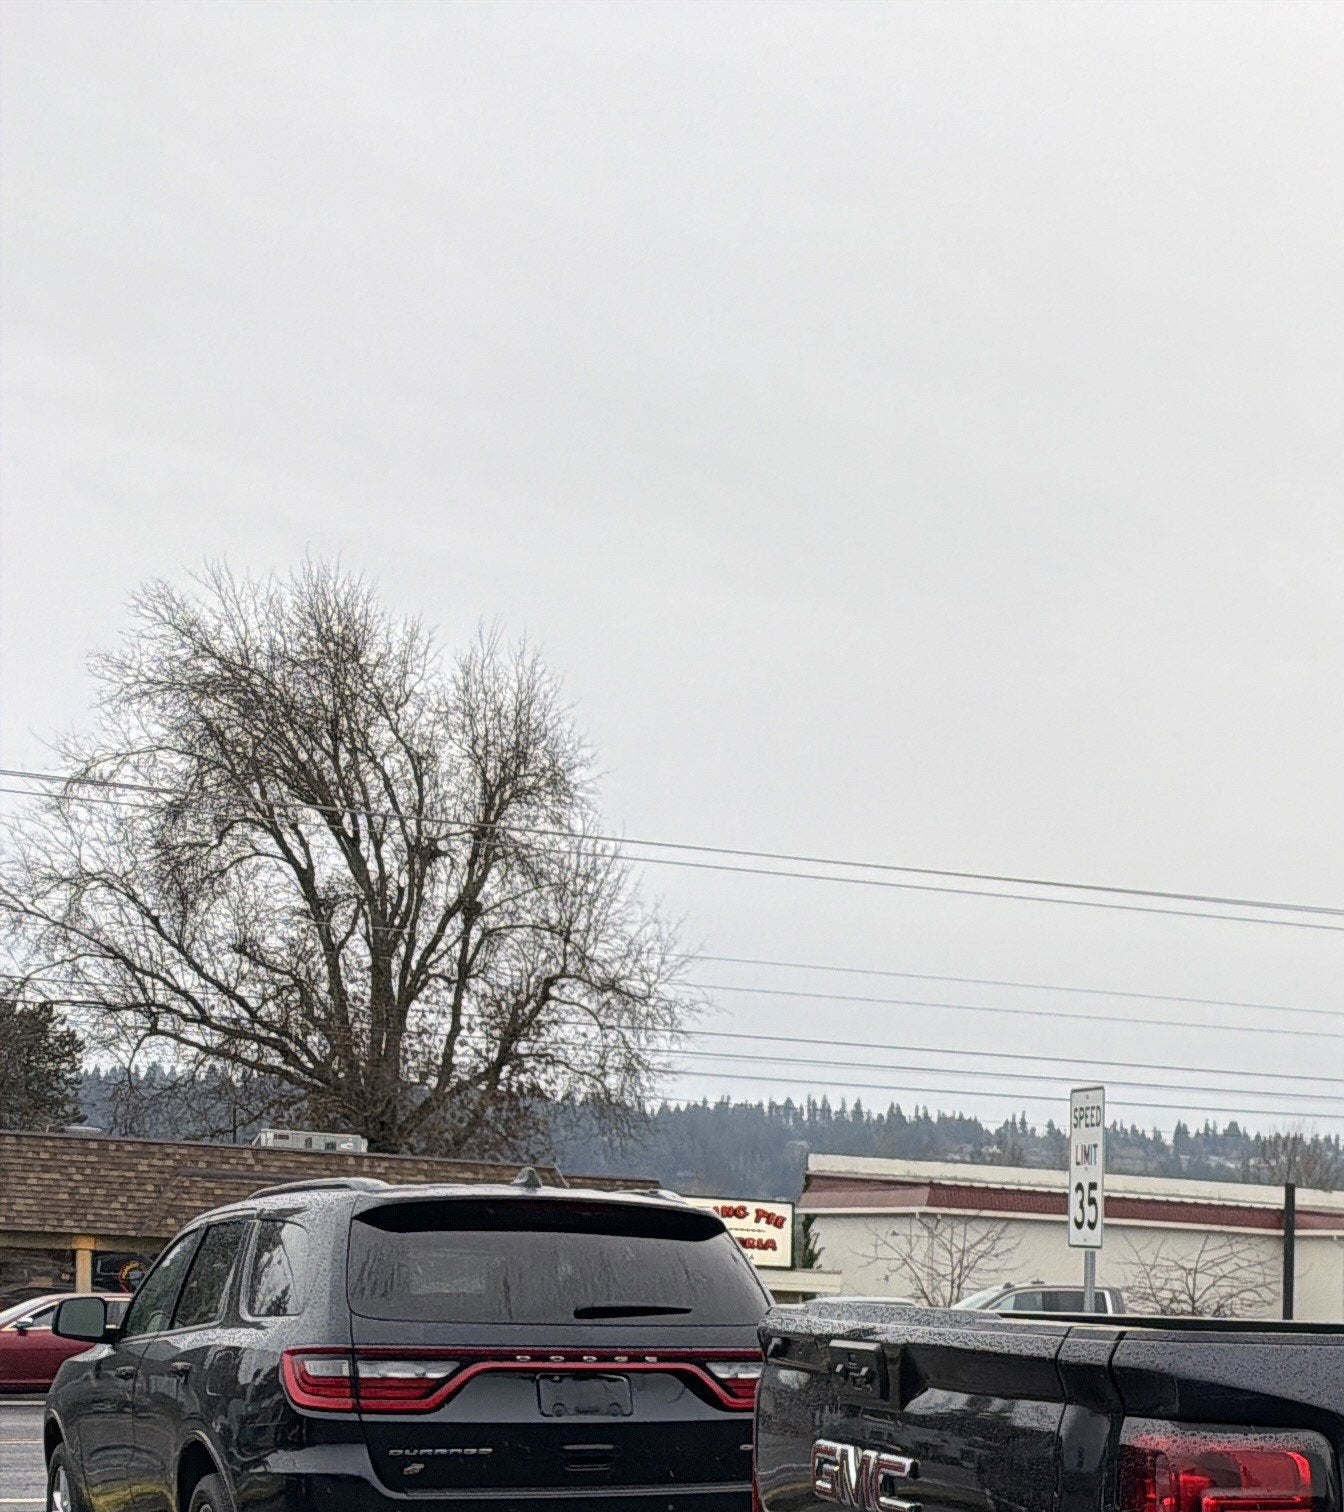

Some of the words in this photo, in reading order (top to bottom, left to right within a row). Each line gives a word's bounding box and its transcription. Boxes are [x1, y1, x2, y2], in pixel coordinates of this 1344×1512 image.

[1073, 1105, 1101, 1129] SPEED
[1075, 1143, 1099, 1166] LIMIT
[1073, 1181, 1099, 1231] 35
[754, 1208, 787, 1229] PIE
